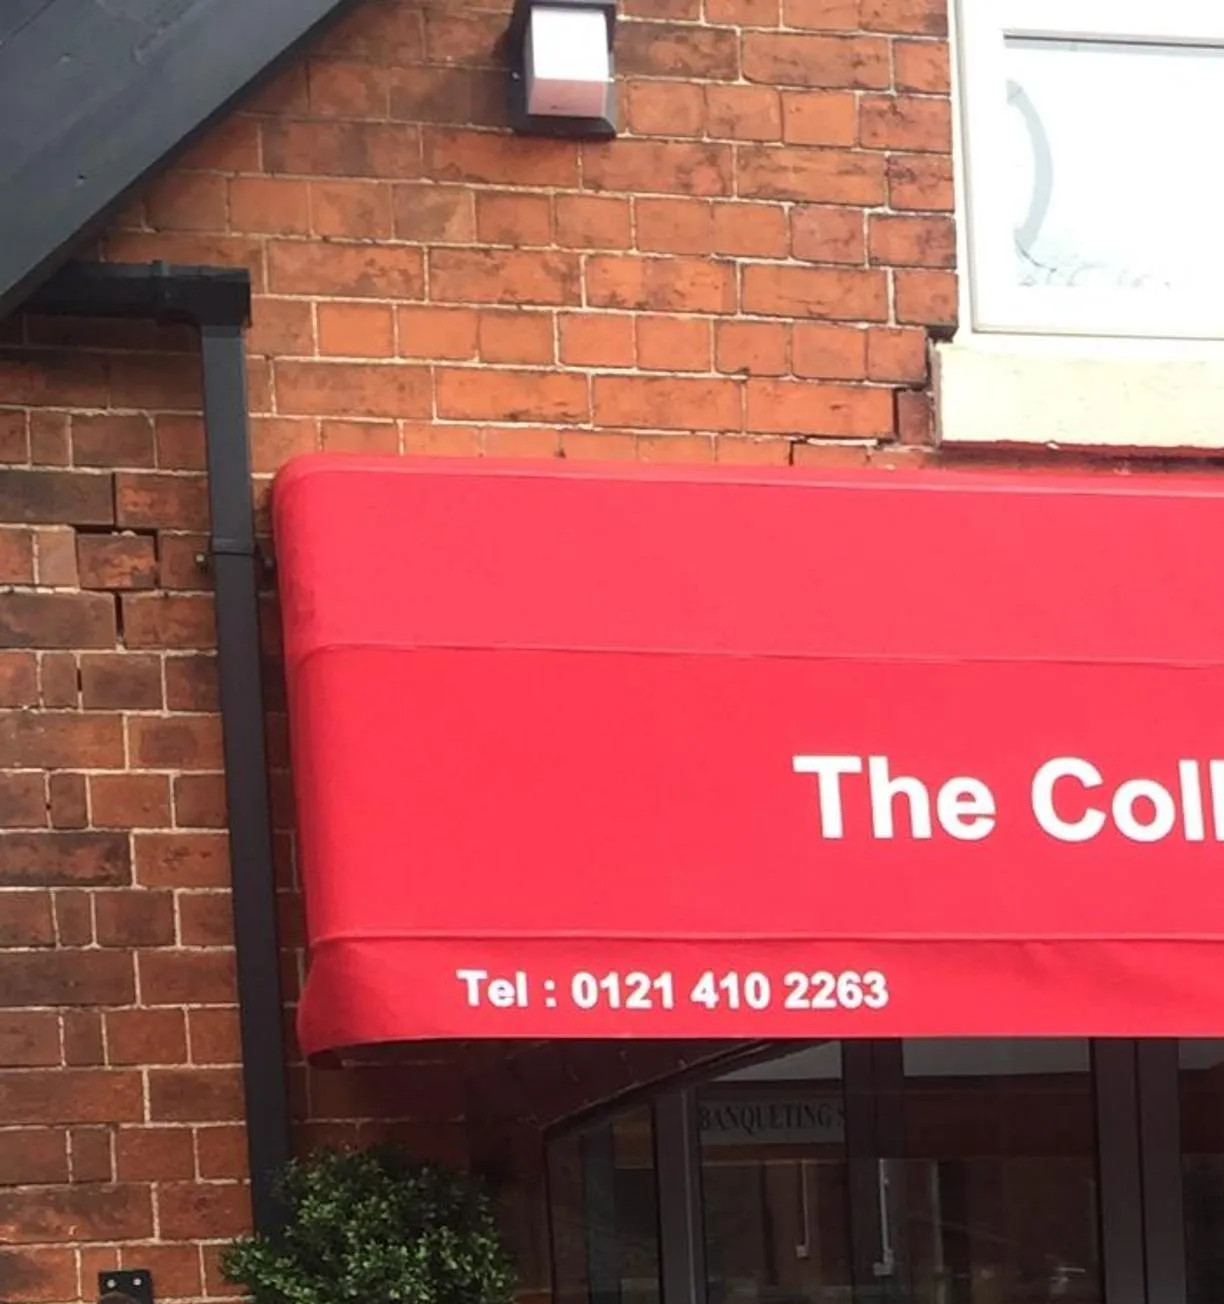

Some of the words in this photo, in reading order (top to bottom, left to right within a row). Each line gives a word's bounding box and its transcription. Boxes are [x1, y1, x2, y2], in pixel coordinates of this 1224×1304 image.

[792, 755, 997, 841] The
[456, 969, 528, 1008] Tel
[571, 971, 675, 1010] 0121
[690, 971, 772, 1010] 410
[784, 971, 890, 1010] 2263
